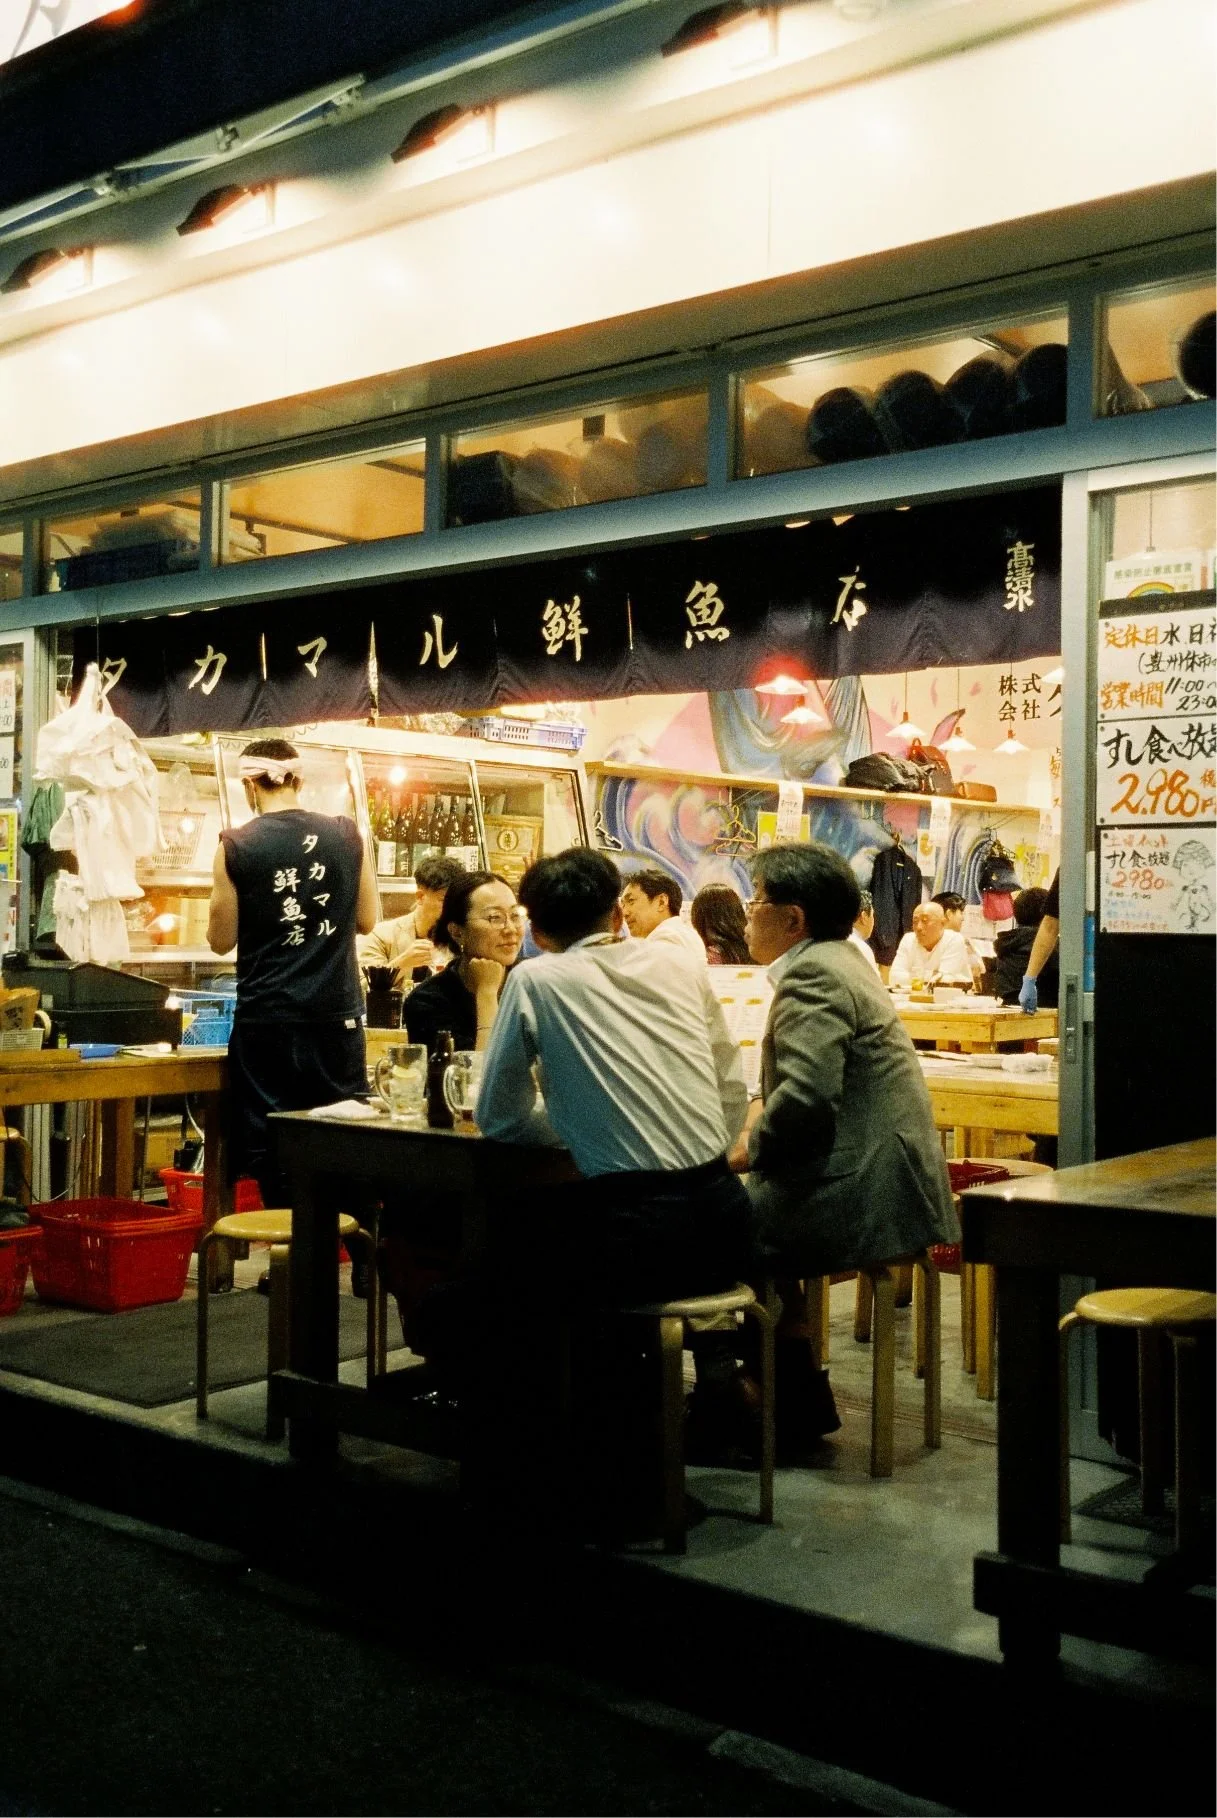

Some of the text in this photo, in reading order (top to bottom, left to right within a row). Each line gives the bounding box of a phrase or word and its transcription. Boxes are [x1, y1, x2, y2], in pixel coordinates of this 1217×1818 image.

[998, 672, 1042, 697] 株式
[998, 699, 1041, 721] 会社
[273, 867, 307, 946] 鮮魚店
[302, 834, 337, 936] タカマル
